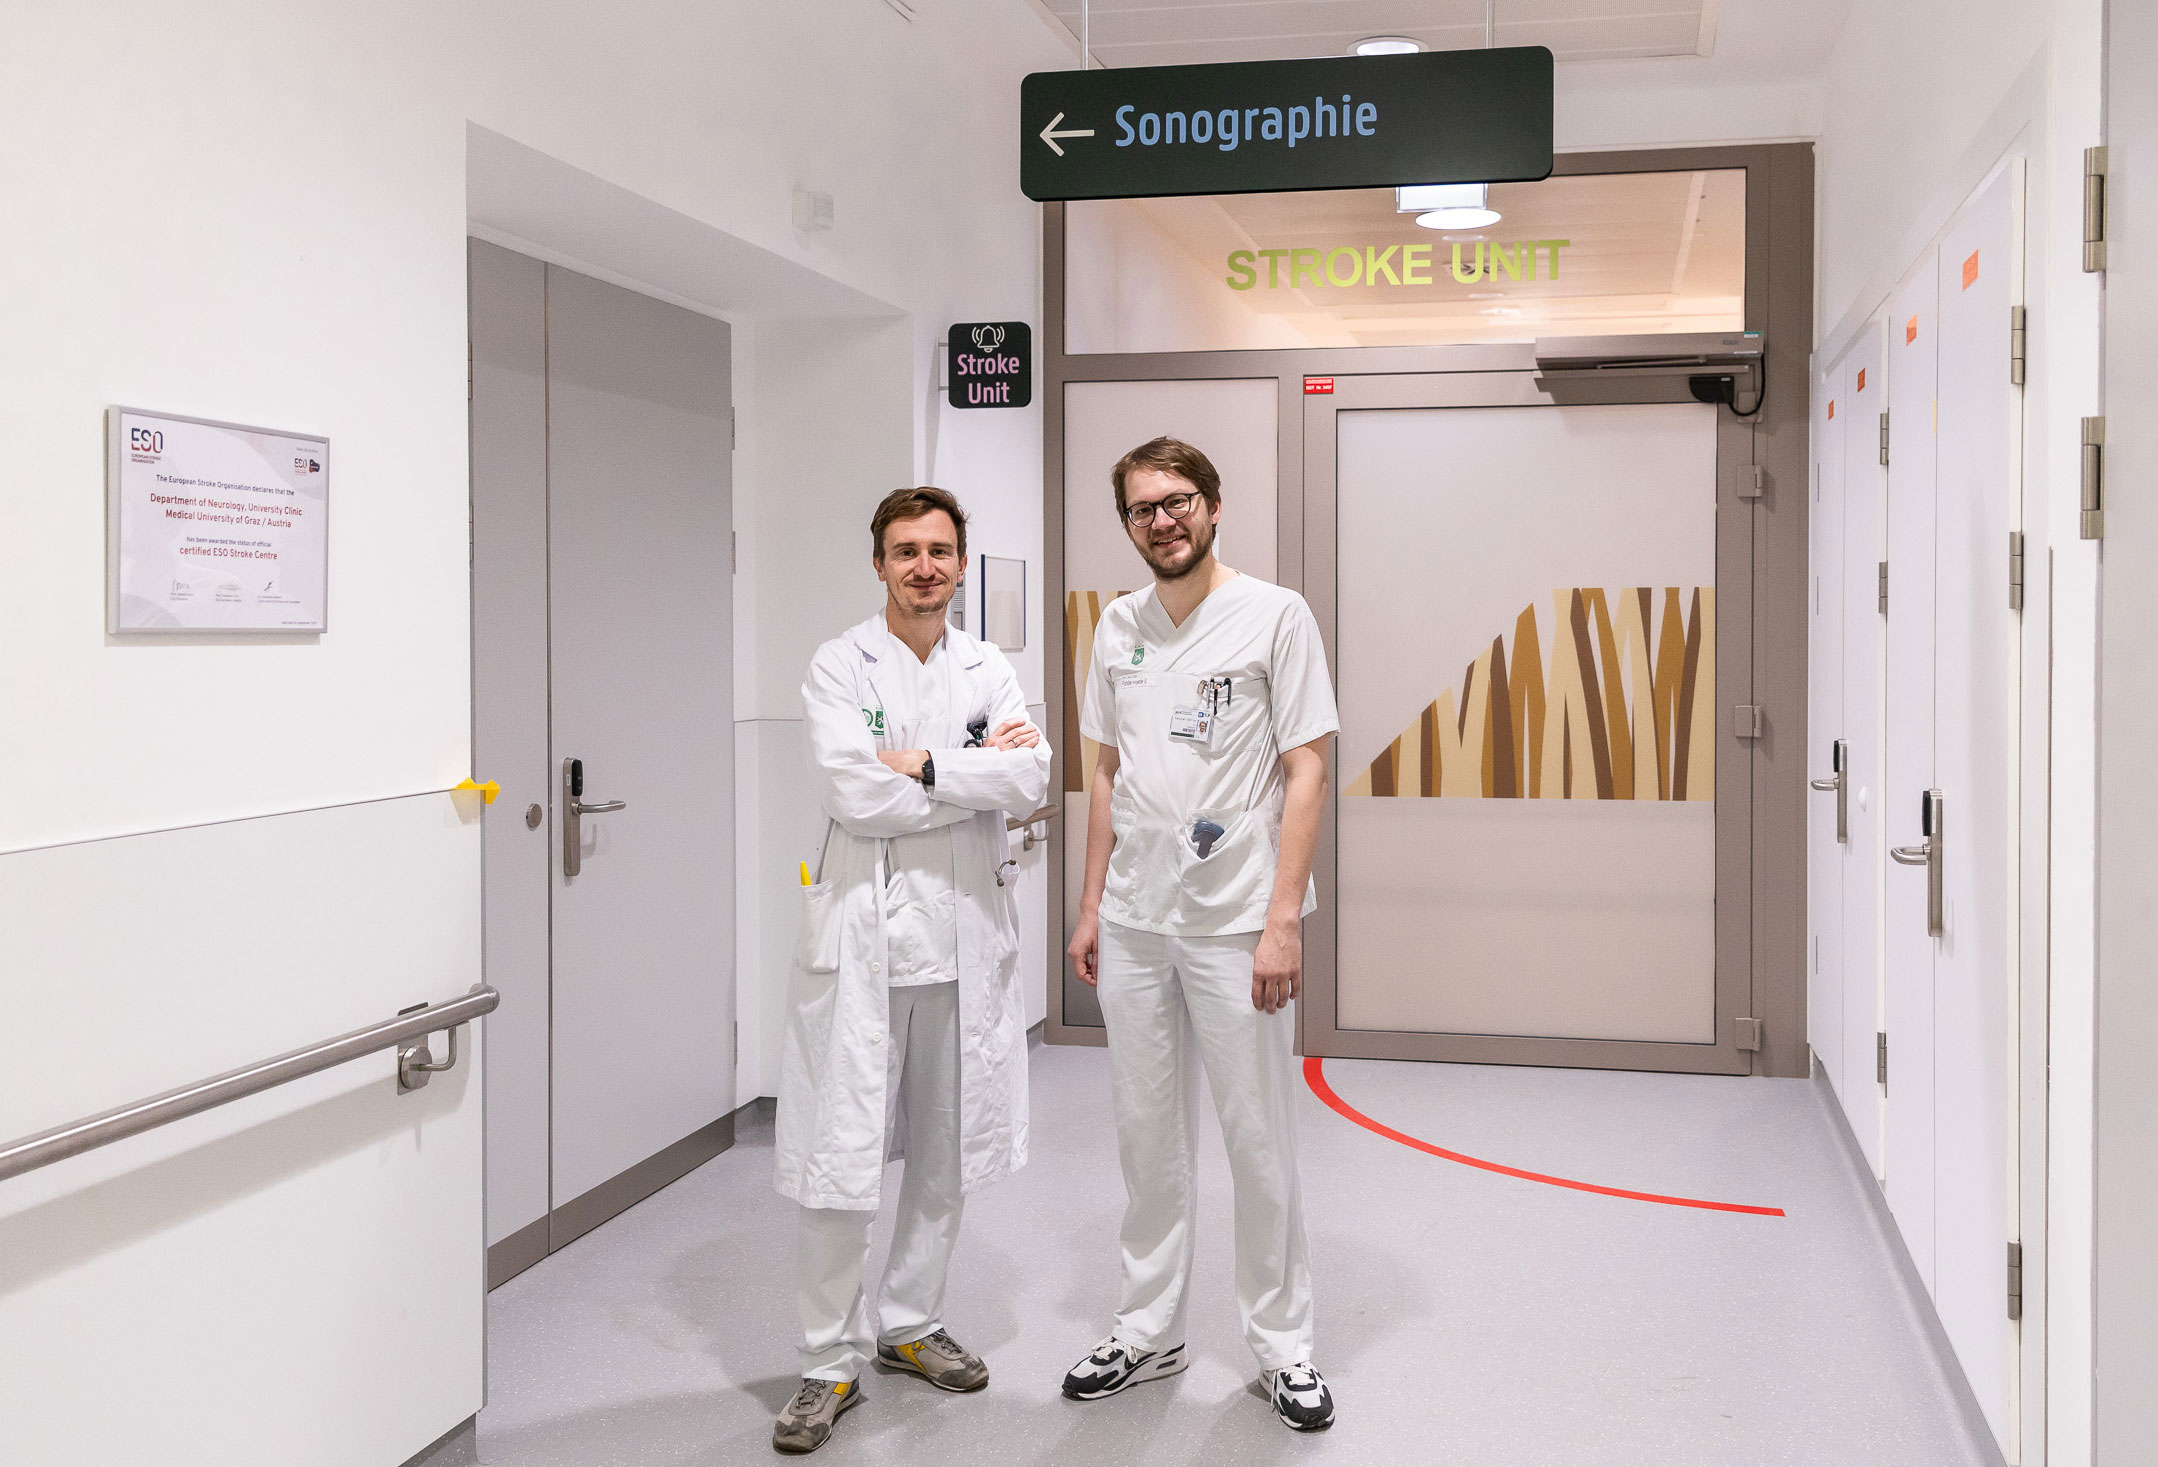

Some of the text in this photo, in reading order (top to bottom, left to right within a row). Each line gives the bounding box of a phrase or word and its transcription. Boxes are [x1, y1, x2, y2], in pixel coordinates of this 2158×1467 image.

[1115, 94, 1377, 151] Sonographie
[1226, 239, 1570, 291] STROKE UNIT
[957, 353, 1020, 375] Stroke
[968, 382, 1010, 404] Unit
[131, 427, 164, 454] ESO
[156, 474, 168, 482] The
[168, 475, 196, 485] European
[197, 479, 216, 487] Stroke
[217, 481, 252, 491] Organisation
[252, 485, 274, 494] declares
[275, 488, 286, 496] that
[150, 492, 303, 516] Department of Neurology, University Clinic
[165, 509, 292, 528] Medical University of Graz / Austria
[179, 546, 278, 560] certified ESO Stroke Centre
